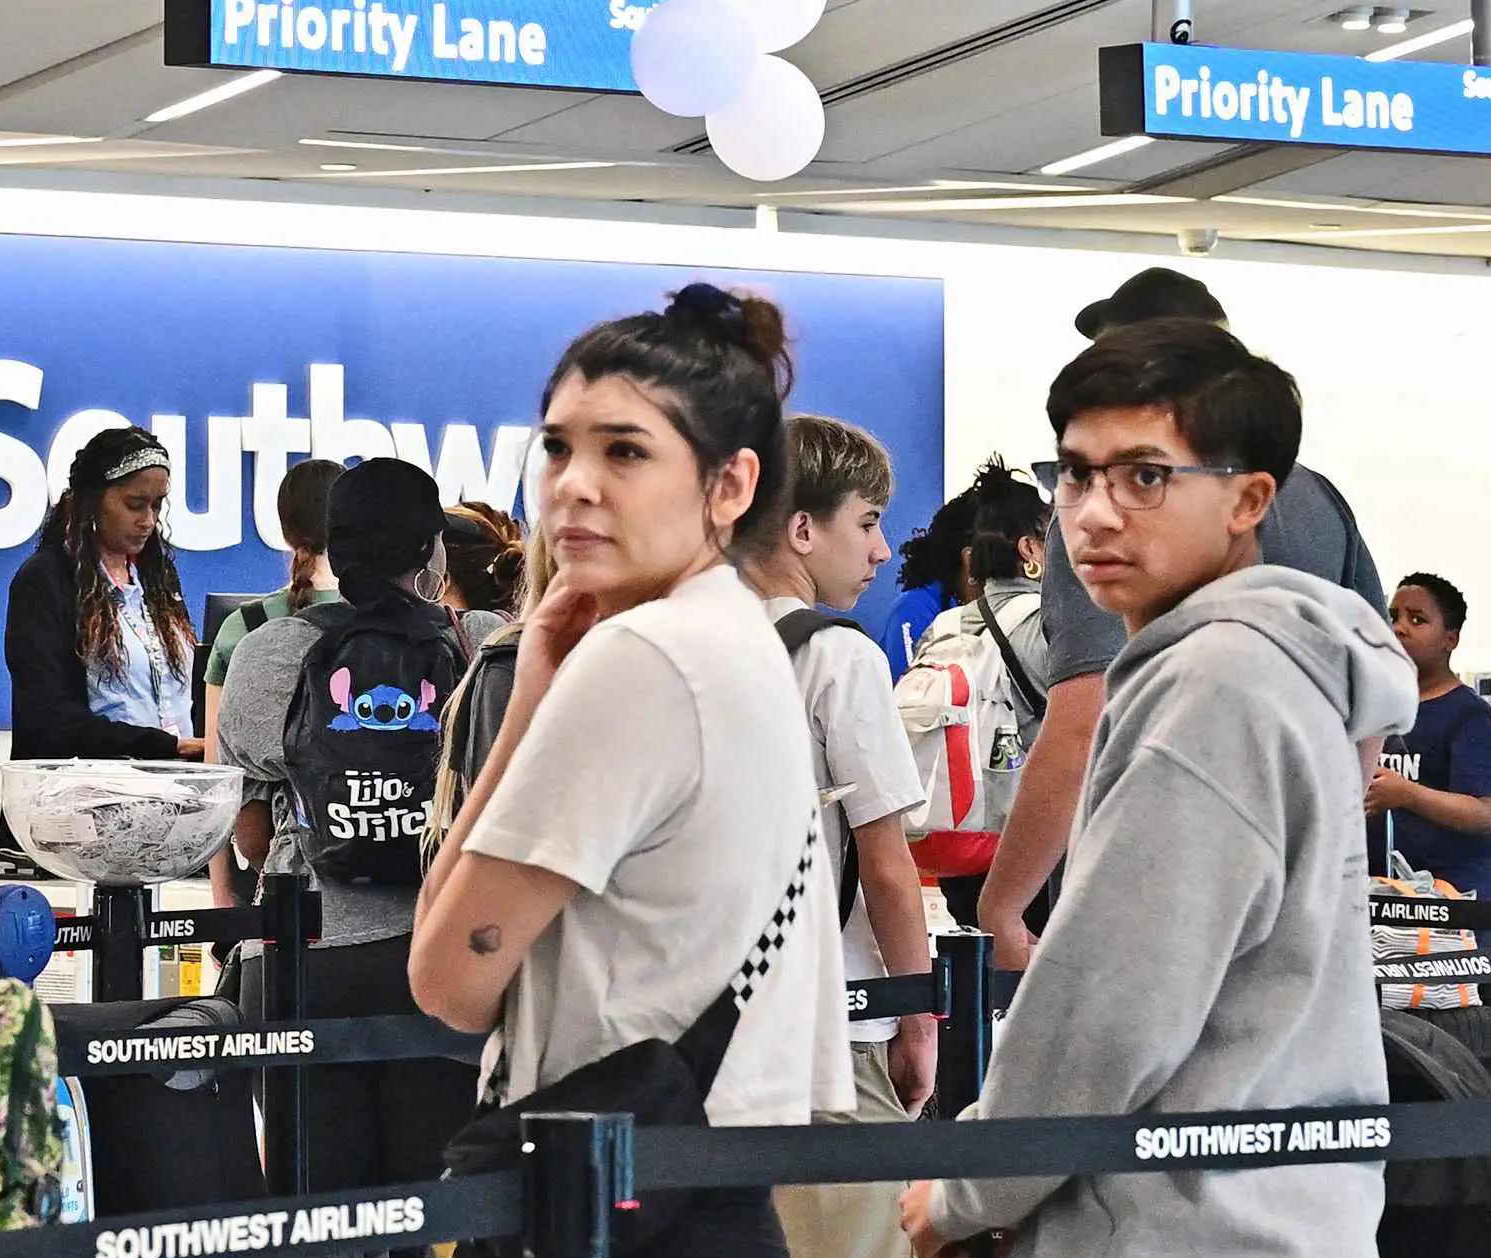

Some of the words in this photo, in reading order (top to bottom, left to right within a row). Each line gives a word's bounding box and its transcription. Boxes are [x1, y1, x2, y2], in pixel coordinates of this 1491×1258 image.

[223, 0, 417, 72] Priority
[434, 3, 547, 66] Lane
[1155, 64, 1312, 138] Priority
[1321, 77, 1414, 131] Lane
[150, 919, 195, 938] LINES
[1381, 902, 1450, 922] AIRLINES
[1412, 956, 1491, 978] SOUTHWEST
[87, 1034, 220, 1064] SOUTHWEST
[222, 1030, 315, 1057] AIRLINES
[1135, 1122, 1286, 1160] SOUTHWEST
[1288, 1117, 1391, 1151] AIRLINES
[290, 1197, 424, 1244] AIRLINES
